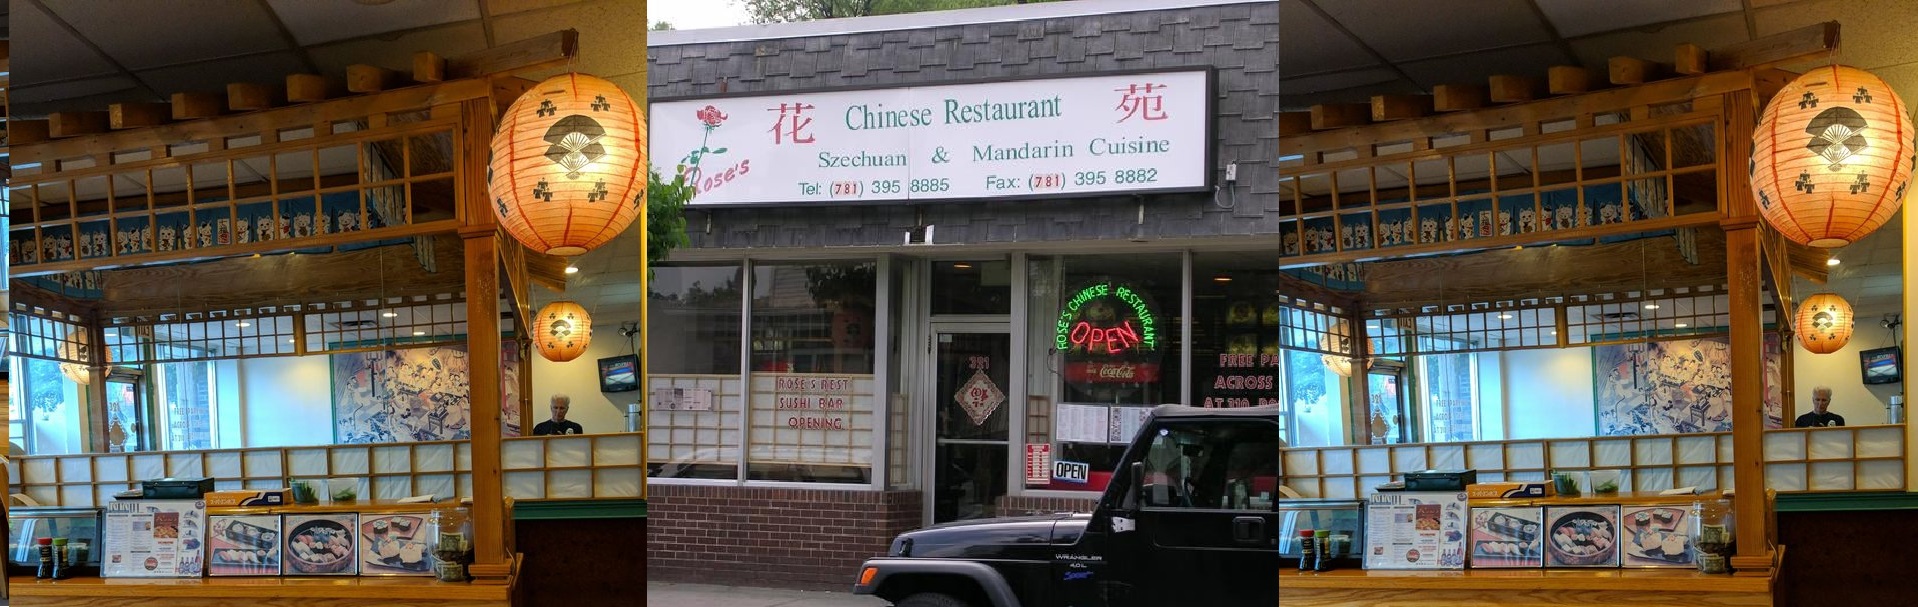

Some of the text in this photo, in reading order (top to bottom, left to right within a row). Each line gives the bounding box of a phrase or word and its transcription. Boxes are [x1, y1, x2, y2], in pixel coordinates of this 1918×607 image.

[846, 94, 1063, 131] Chinese Restaurant
[1113, 82, 1169, 125] 苑
[767, 102, 816, 145] 花
[818, 136, 1170, 168] Szechuan & Mandarin Cuisine
[798, 178, 950, 198] Tel: (781) 395 8885
[986, 168, 1158, 192] Fax: (781) 395 8882
[1068, 284, 1108, 311] CHINESE
[1115, 286, 1157, 351] RESTAURANT
[1070, 320, 1140, 354] OPEN
[1219, 353, 1255, 368] FREE
[820, 378, 849, 390] REST
[1214, 375, 1273, 390] ACROSS
[779, 397, 843, 410] SUSHI BAR
[788, 416, 842, 430] OPENING
[1056, 462, 1087, 480] OPEN
